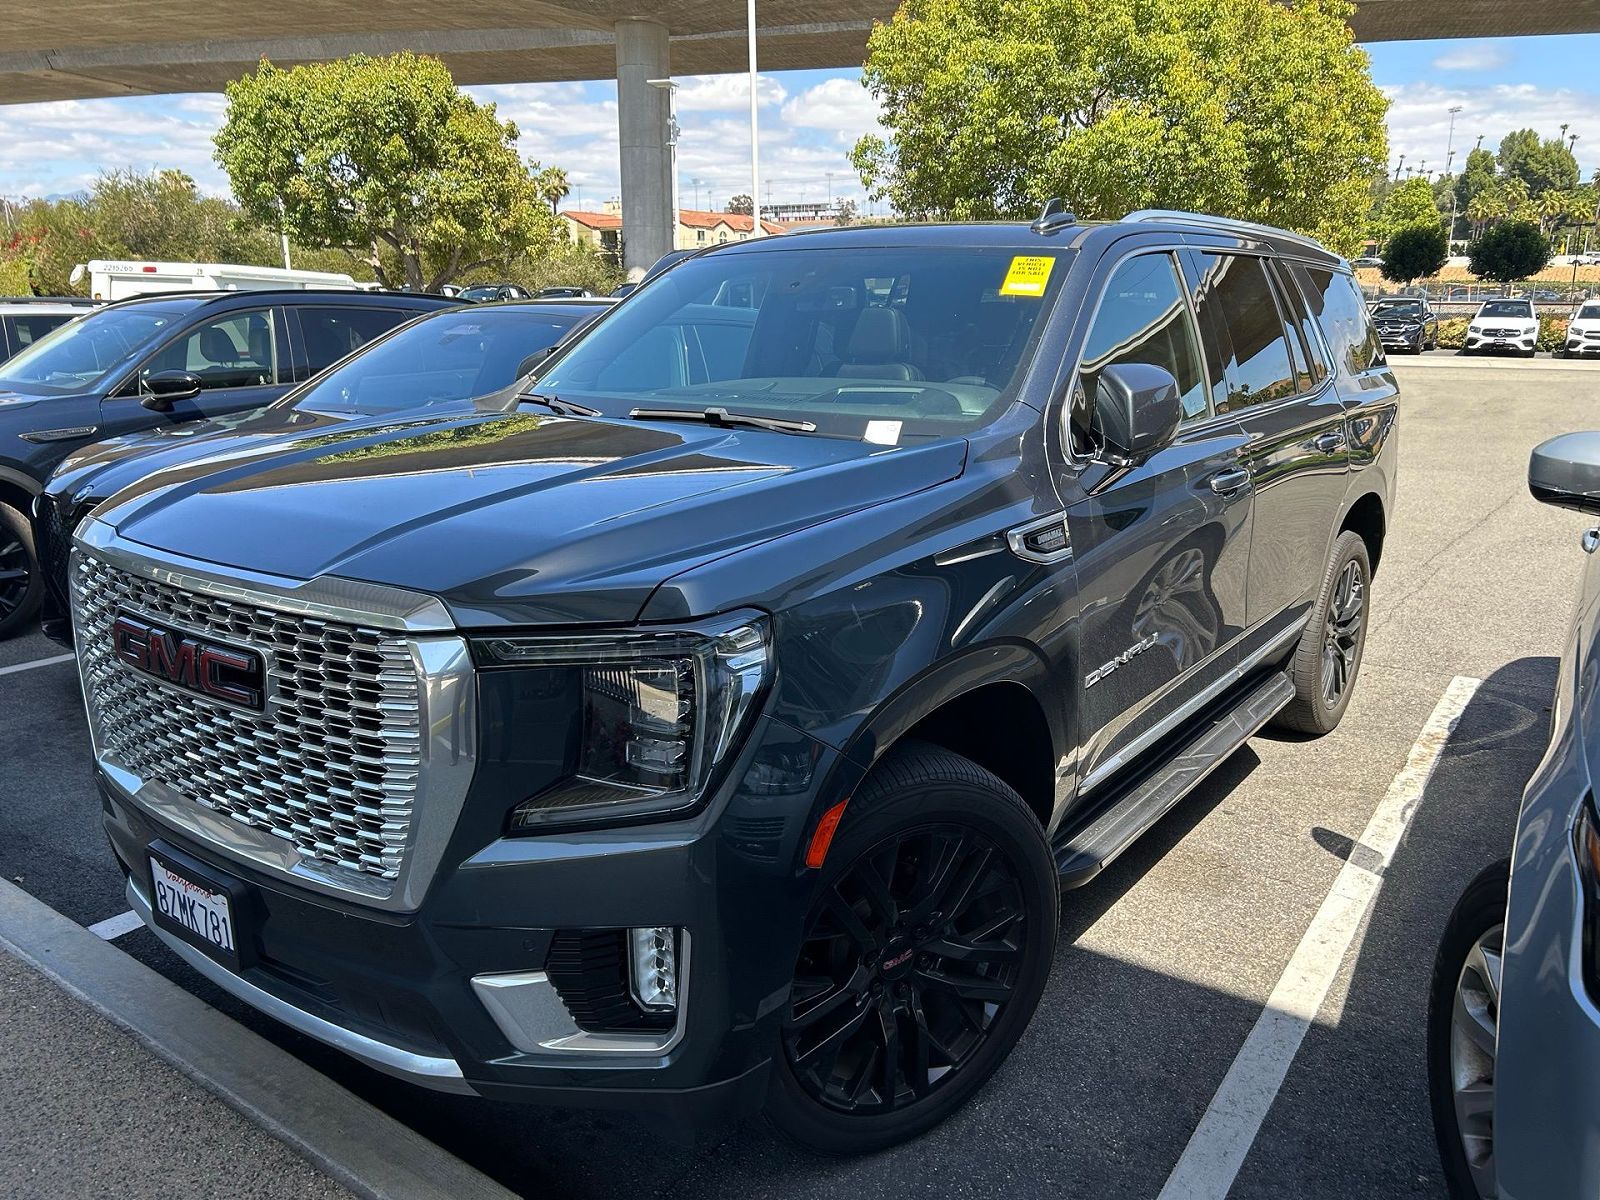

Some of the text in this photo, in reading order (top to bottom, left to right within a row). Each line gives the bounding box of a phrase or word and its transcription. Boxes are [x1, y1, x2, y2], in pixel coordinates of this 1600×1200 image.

[113, 616, 259, 707] GMC
[1084, 631, 1159, 690] DENALI
[157, 880, 234, 952] 8ZMK781
[882, 948, 913, 970] GMC
